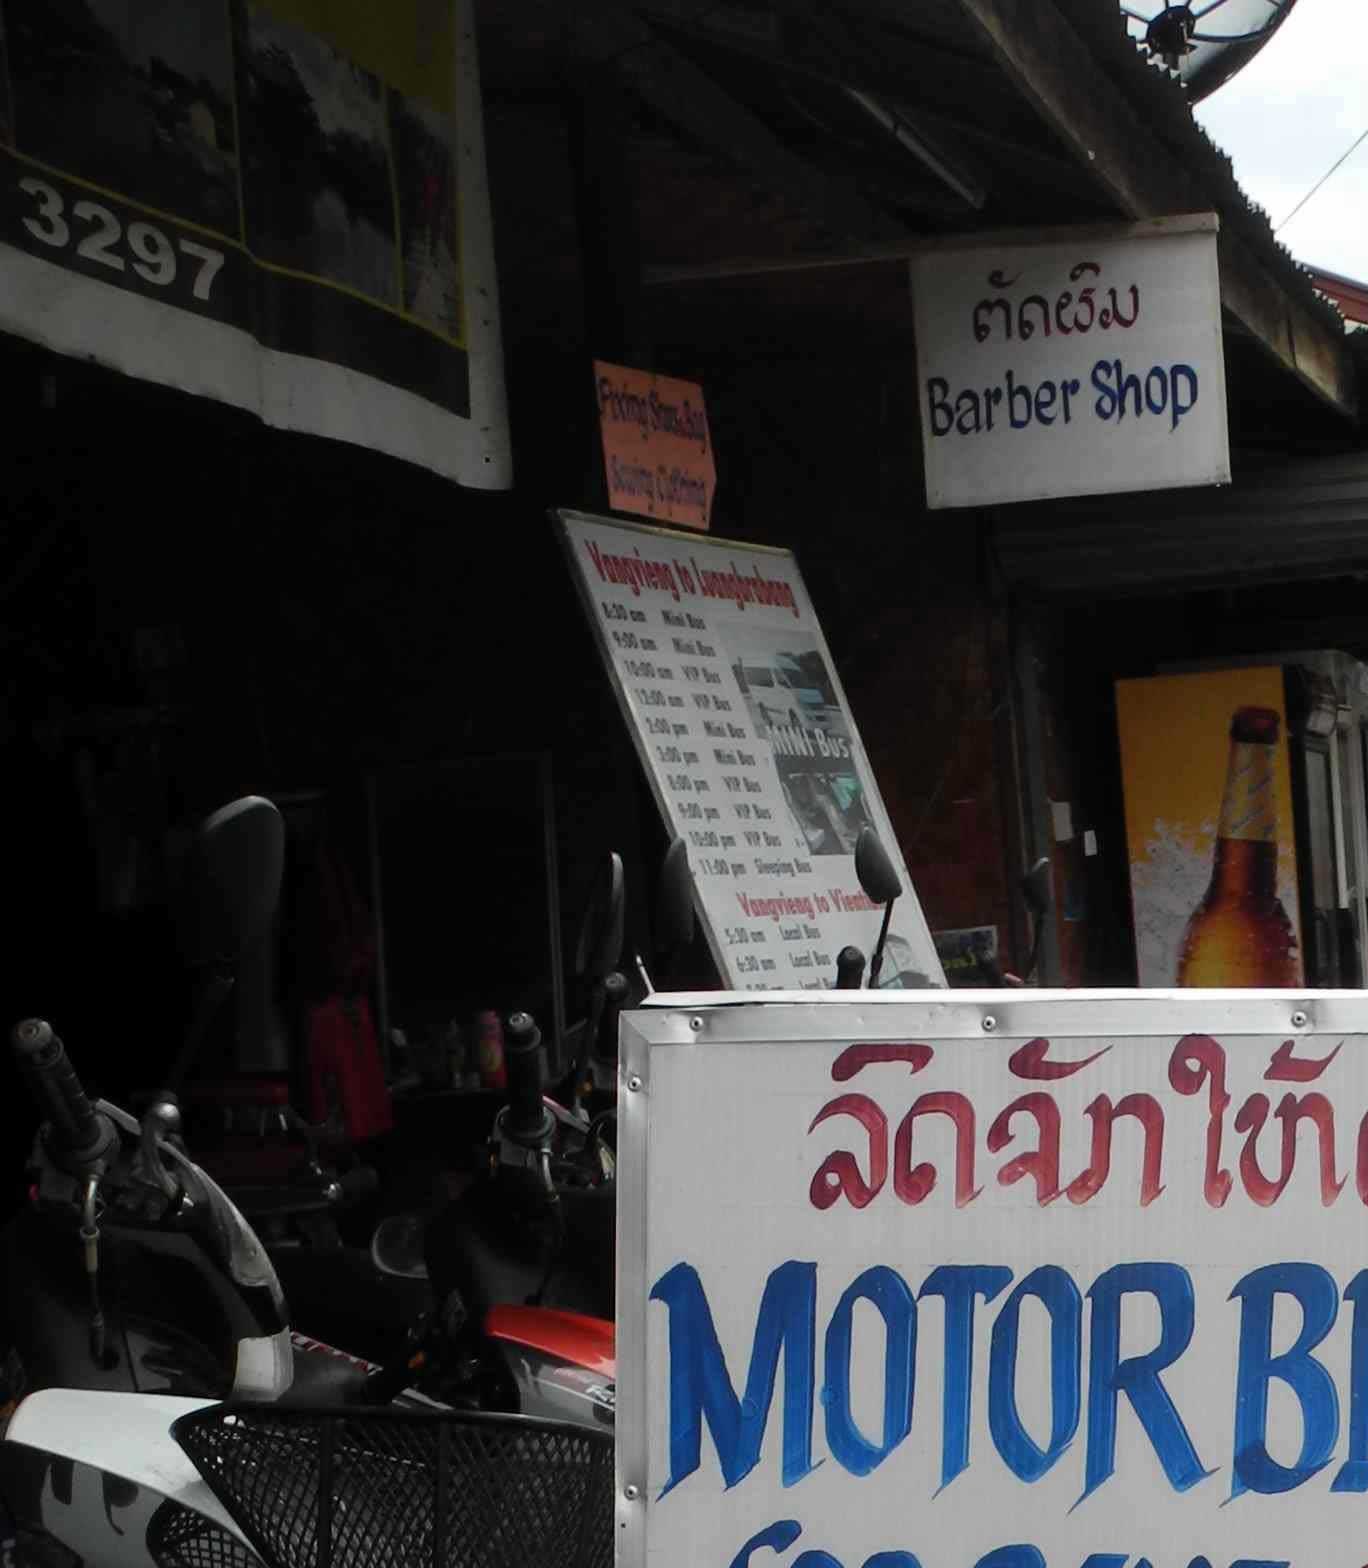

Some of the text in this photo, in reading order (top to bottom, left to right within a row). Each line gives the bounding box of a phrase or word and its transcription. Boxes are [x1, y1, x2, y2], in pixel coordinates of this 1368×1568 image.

[18, 176, 225, 301] 3297
[926, 357, 1199, 437] Barber Shop
[584, 539, 681, 602] Vangvieng
[673, 558, 697, 594] to
[686, 612, 707, 630] Bus
[696, 640, 717, 657] Bus
[701, 667, 722, 684] Bus
[711, 694, 732, 711] Bus
[726, 722, 747, 739] Bus
[737, 750, 756, 766] Bus
[742, 777, 762, 792] Bus
[752, 804, 772, 820] Bus
[762, 831, 783, 847] Bus
[793, 858, 813, 873] Bus
[814, 892, 831, 913] to
